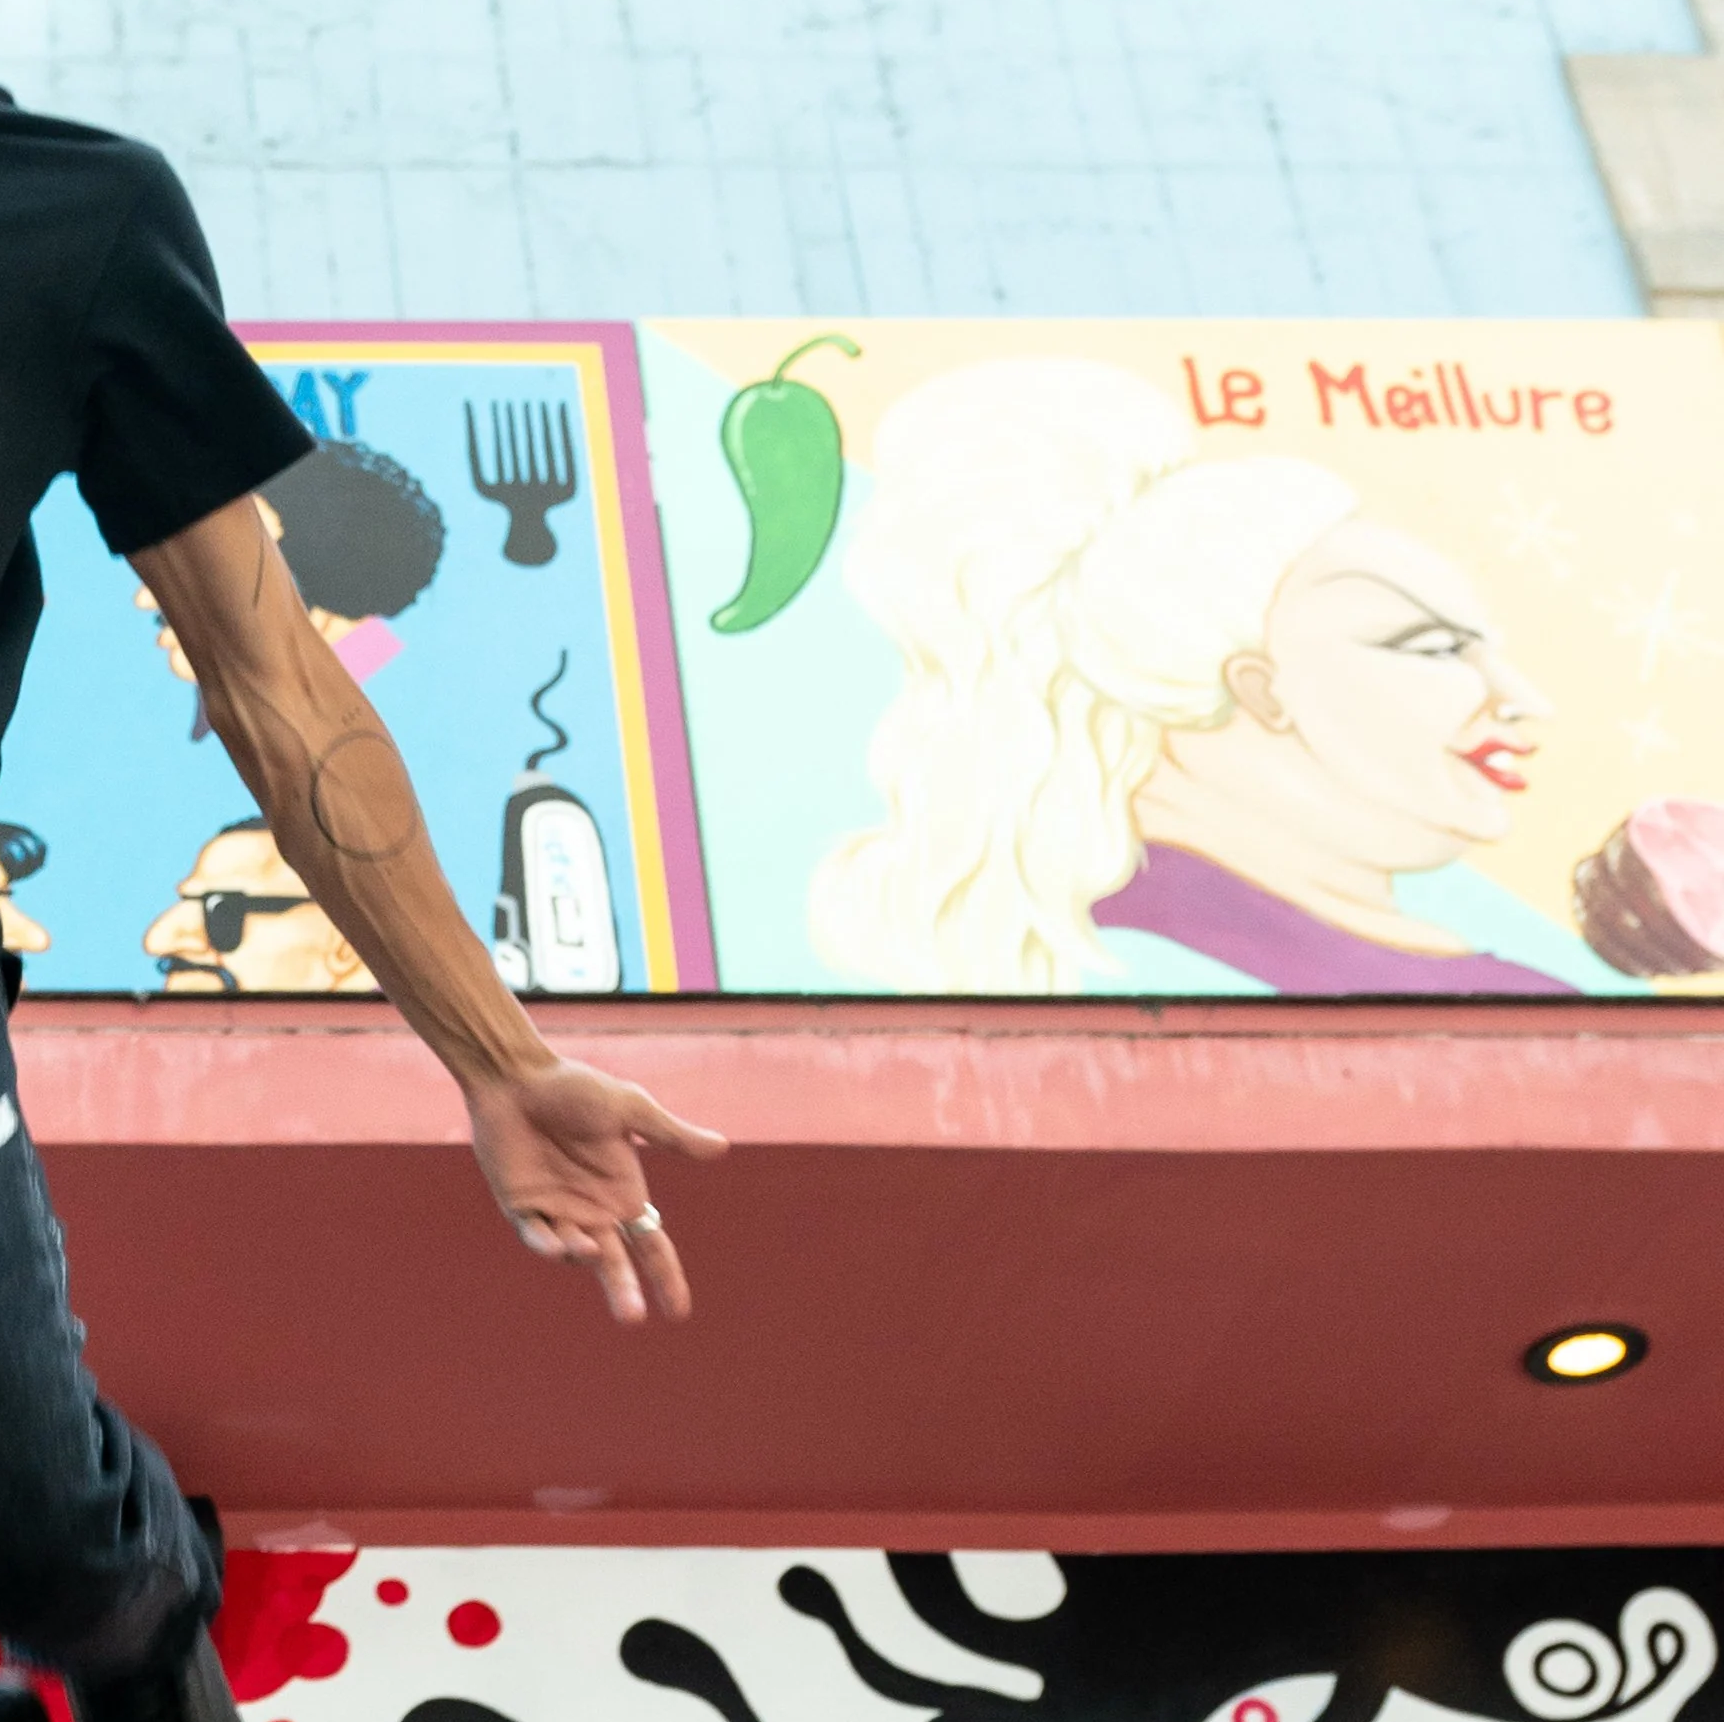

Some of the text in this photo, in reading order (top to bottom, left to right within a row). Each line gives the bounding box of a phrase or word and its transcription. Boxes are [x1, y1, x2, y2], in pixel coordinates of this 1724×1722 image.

[272, 369, 372, 441] AY
[1181, 355, 1615, 436] Le Meillure
